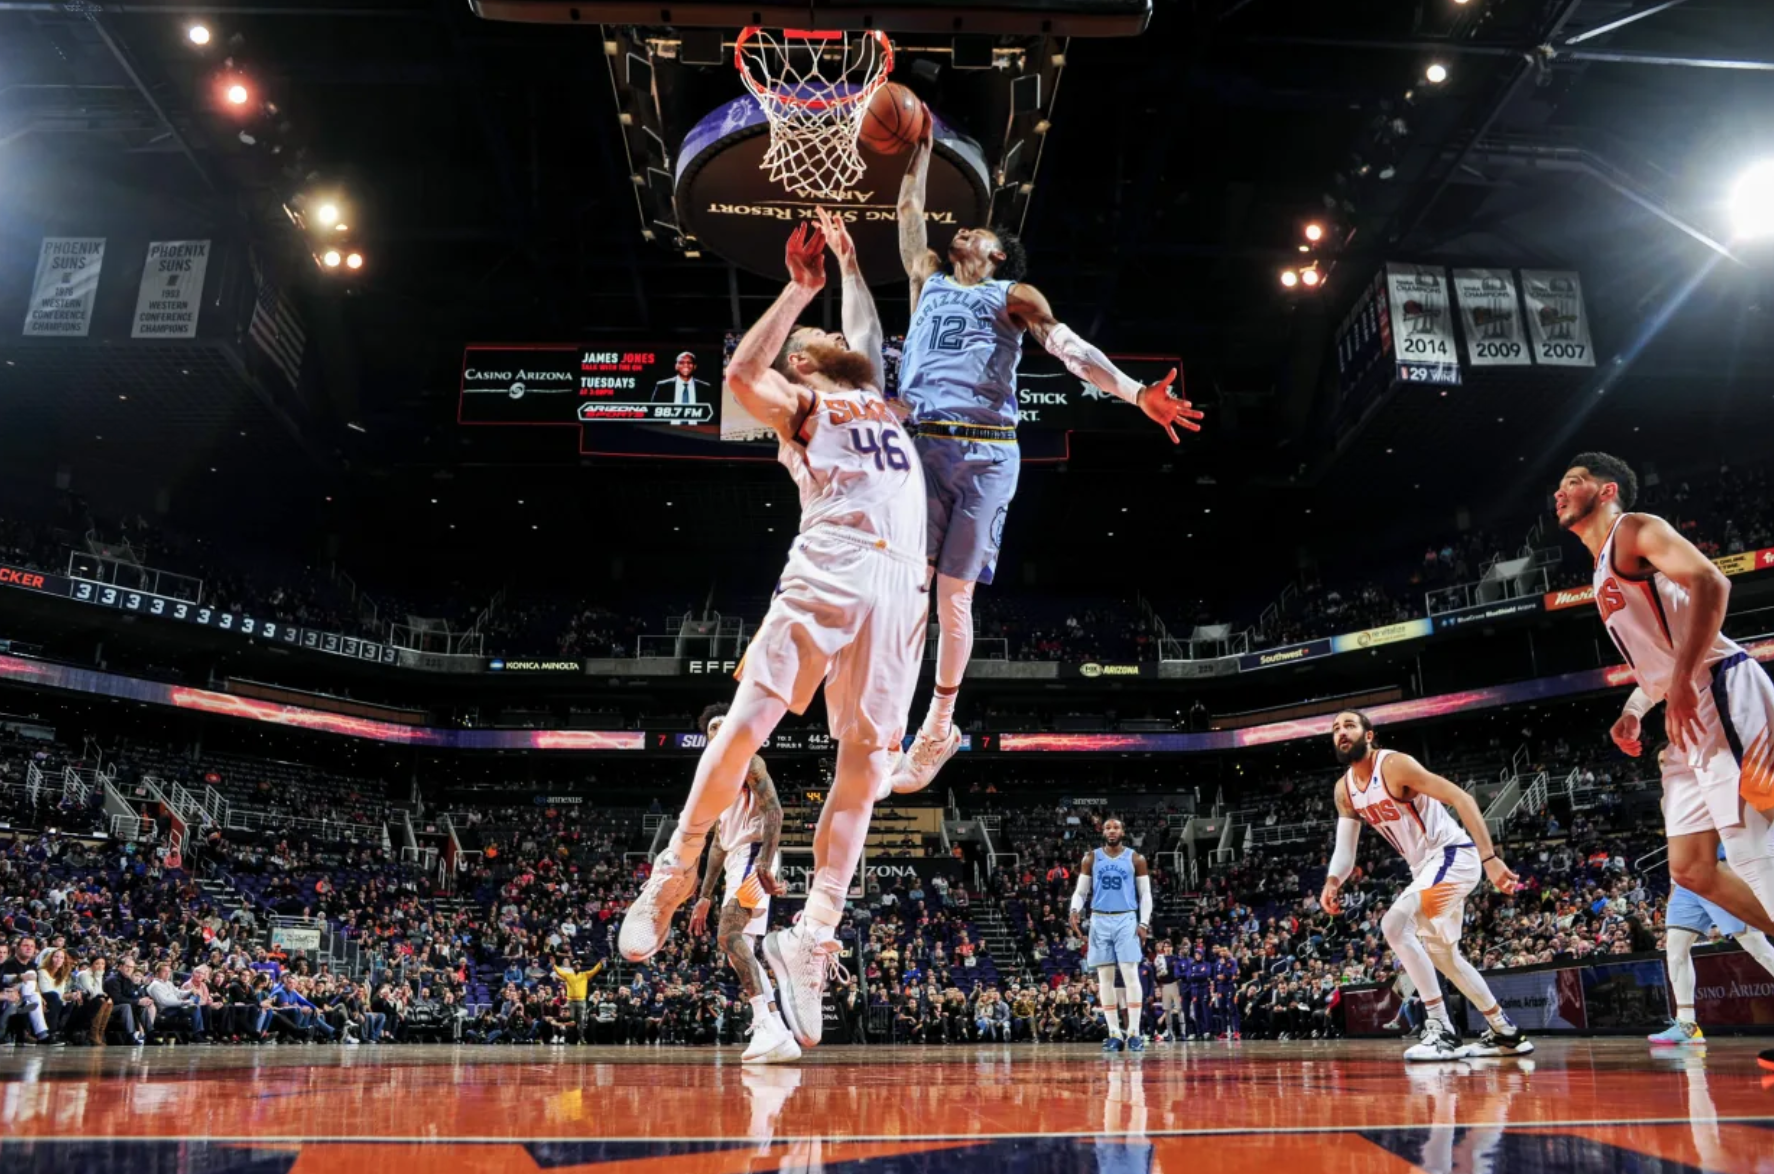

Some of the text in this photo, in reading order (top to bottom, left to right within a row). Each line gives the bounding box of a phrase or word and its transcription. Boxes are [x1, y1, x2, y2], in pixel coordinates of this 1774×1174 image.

[707, 203, 792, 220] RESORT
[44, 242, 101, 255] PHOENIX
[151, 245, 206, 258] PHOENIX
[52, 256, 86, 269] SUNS
[158, 259, 192, 272] SUNS
[42, 298, 82, 308] WESTERN
[149, 300, 188, 310] WESTERN
[32, 309, 85, 320] CONFERENCE
[139, 312, 193, 322] CONFERENCE
[32, 321, 82, 332] CHAMPIONS
[140, 324, 189, 334] CHAMPIONS
[928, 315, 966, 350] 12
[1404, 338, 1448, 355] 2014
[1476, 342, 1521, 358] 2009
[1542, 342, 1585, 358] 2007
[581, 352, 655, 364] JAMES JONES
[464, 368, 573, 380] CASINO ARIZONA
[1410, 367, 1428, 380] 29
[580, 377, 635, 388] TUESDAYS
[1020, 388, 1068, 405] STICK
[654, 407, 703, 418] 98.7 FM
[850, 428, 909, 471] 46
[77, 584, 92, 598] 3
[102, 589, 117, 604] 3
[126, 595, 141, 609] 3
[150, 599, 165, 614] 3
[174, 604, 187, 618] 3
[197, 609, 211, 624] 3
[220, 614, 233, 628] 3
[242, 619, 254, 632] 3
[263, 623, 276, 637] 3
[284, 628, 297, 641] 3
[1260, 649, 1303, 664] Southwest
[506, 661, 579, 670] KONICA MINOLTA
[1102, 666, 1138, 674] ARIZONA
[658, 735, 667, 746] 7
[808, 734, 830, 743] 44.2
[982, 736, 991, 748] 7
[1101, 876, 1123, 890] 99
